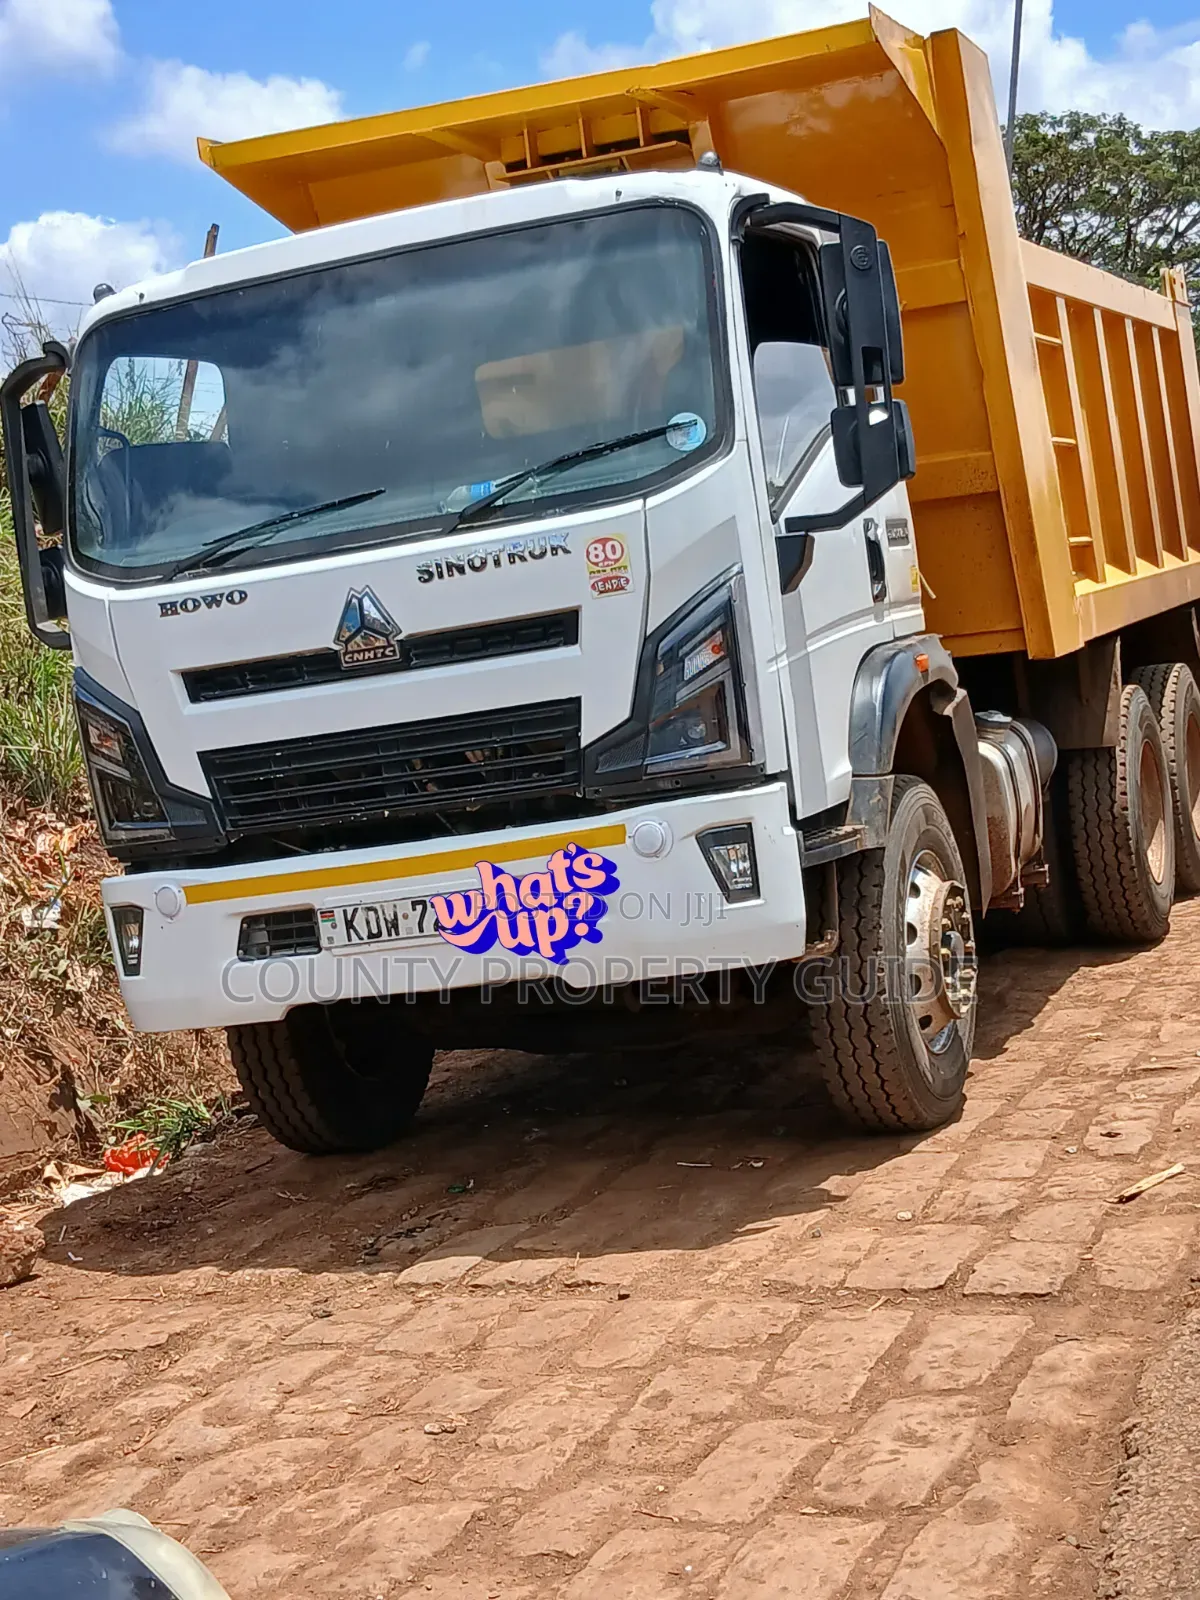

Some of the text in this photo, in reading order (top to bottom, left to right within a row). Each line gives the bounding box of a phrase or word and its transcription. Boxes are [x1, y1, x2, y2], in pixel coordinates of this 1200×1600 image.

[416, 533, 571, 583] SINOTRUK
[588, 540, 622, 563] 80
[157, 589, 248, 618] HOWO
[345, 646, 395, 662] CNHTC
[343, 903, 401, 943] KDW
